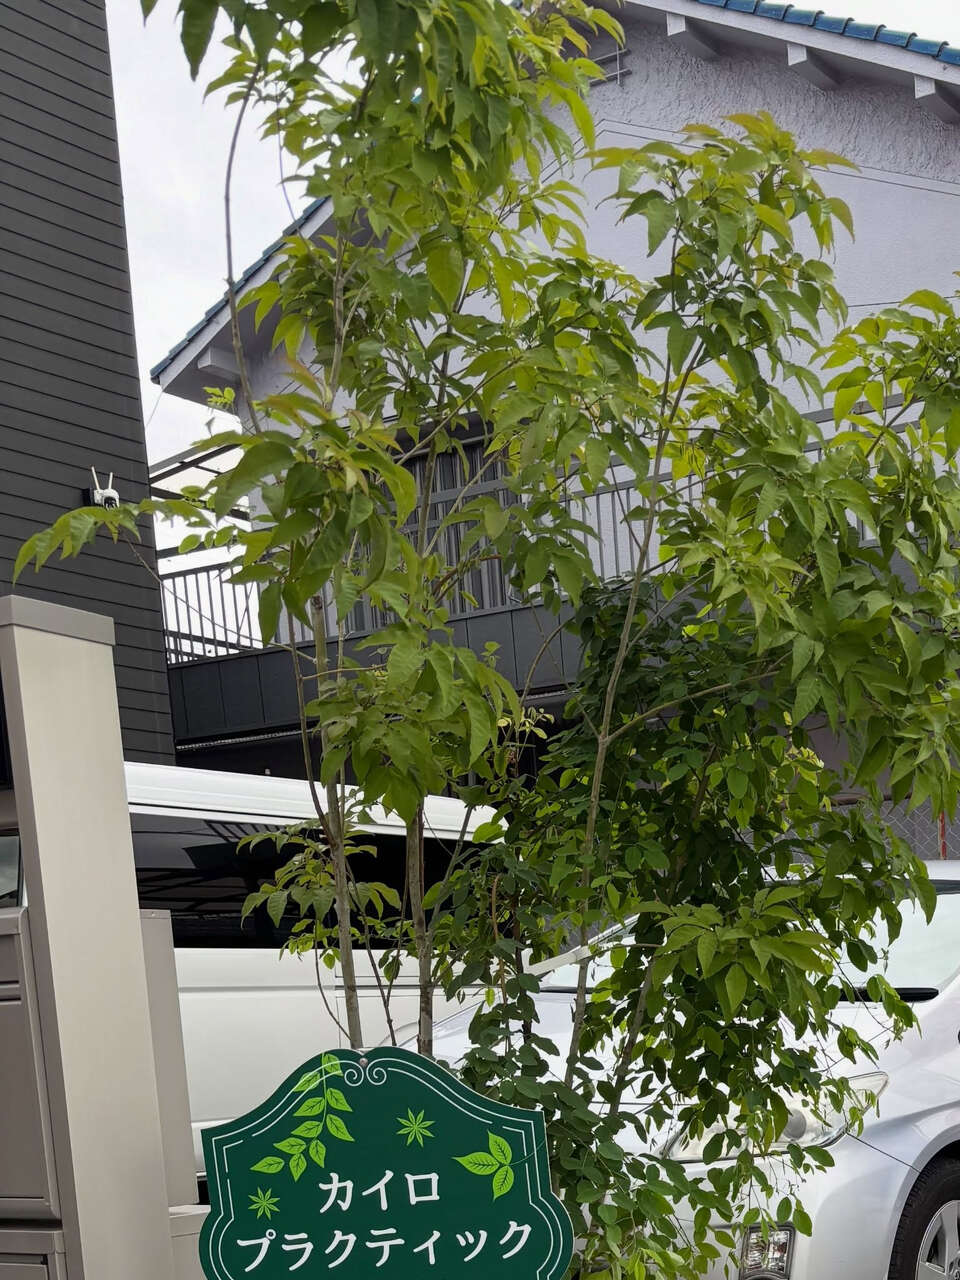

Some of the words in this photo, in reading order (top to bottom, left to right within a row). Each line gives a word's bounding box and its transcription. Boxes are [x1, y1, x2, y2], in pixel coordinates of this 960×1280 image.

[318, 1169, 440, 1214] カイロ
[236, 1220, 533, 1273] プラクティック
